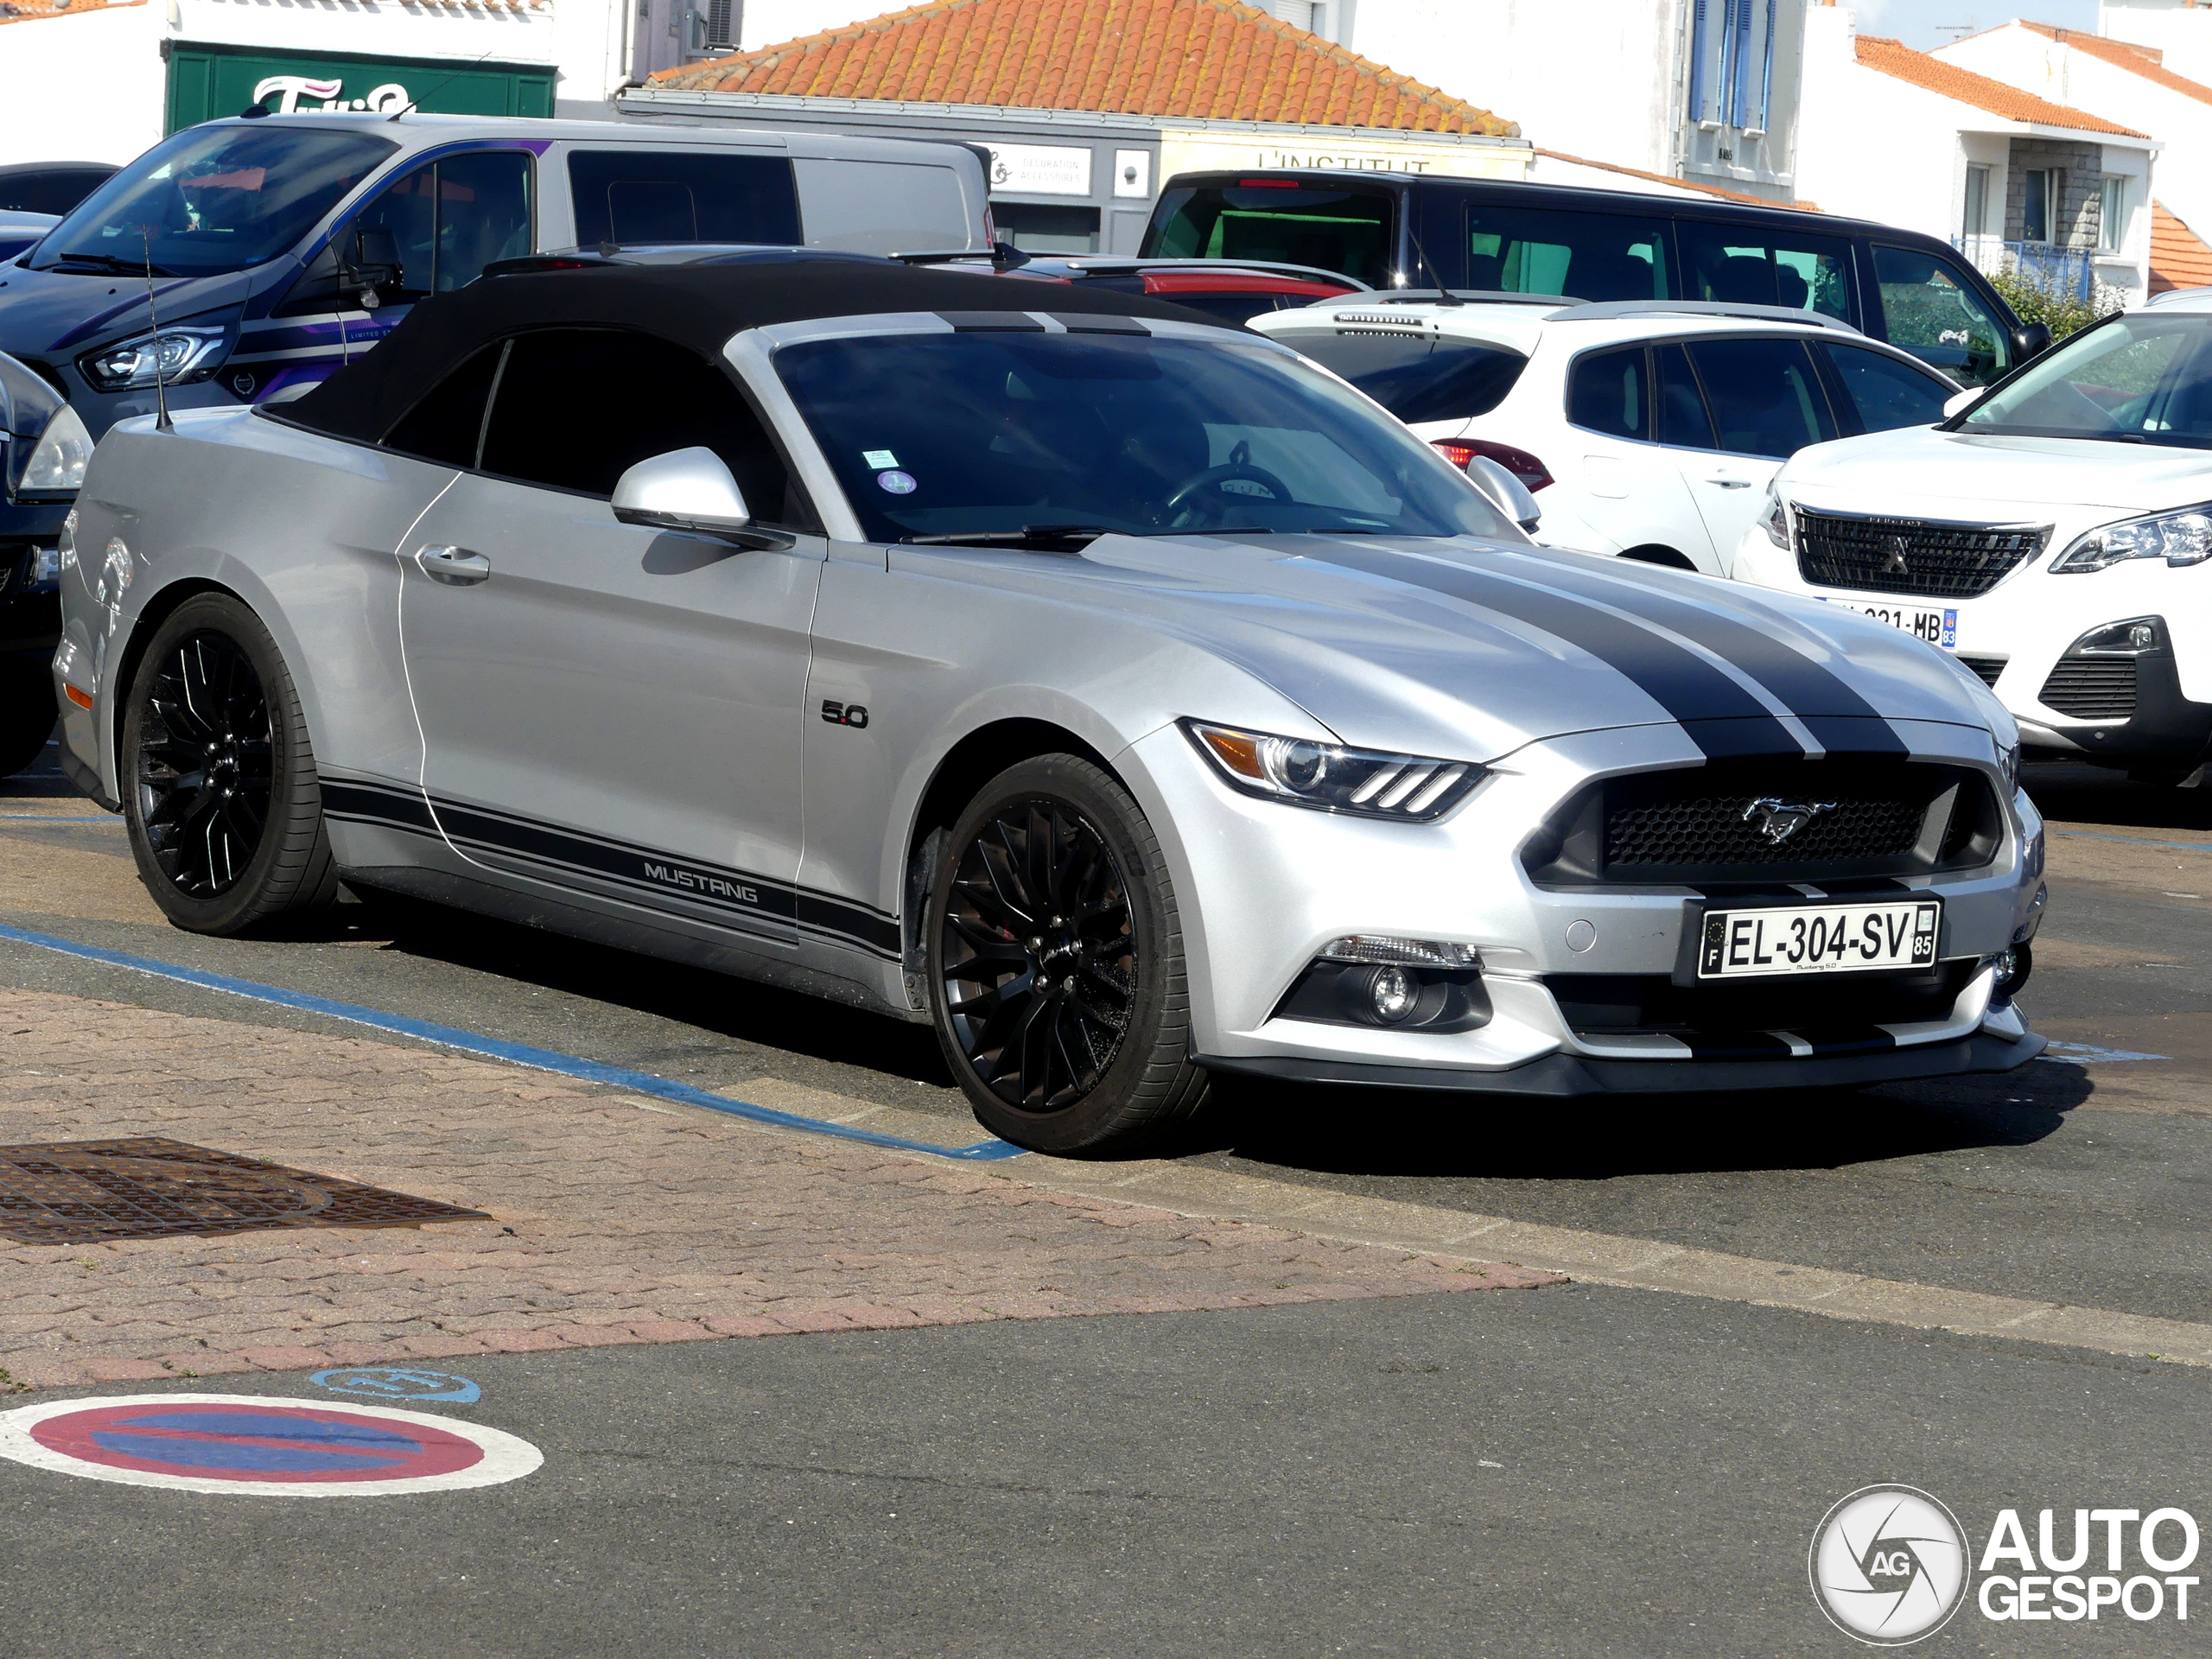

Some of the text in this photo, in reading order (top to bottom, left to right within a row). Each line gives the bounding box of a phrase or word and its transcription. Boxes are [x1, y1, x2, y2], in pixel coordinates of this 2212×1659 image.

[1020, 171, 1081, 183] ACCESSOIRES
[1942, 631, 1955, 644] 83
[822, 699, 868, 729] 5.0
[644, 862, 759, 903] MUSTANG
[1707, 912, 1932, 967] F EL-304-SV 85
